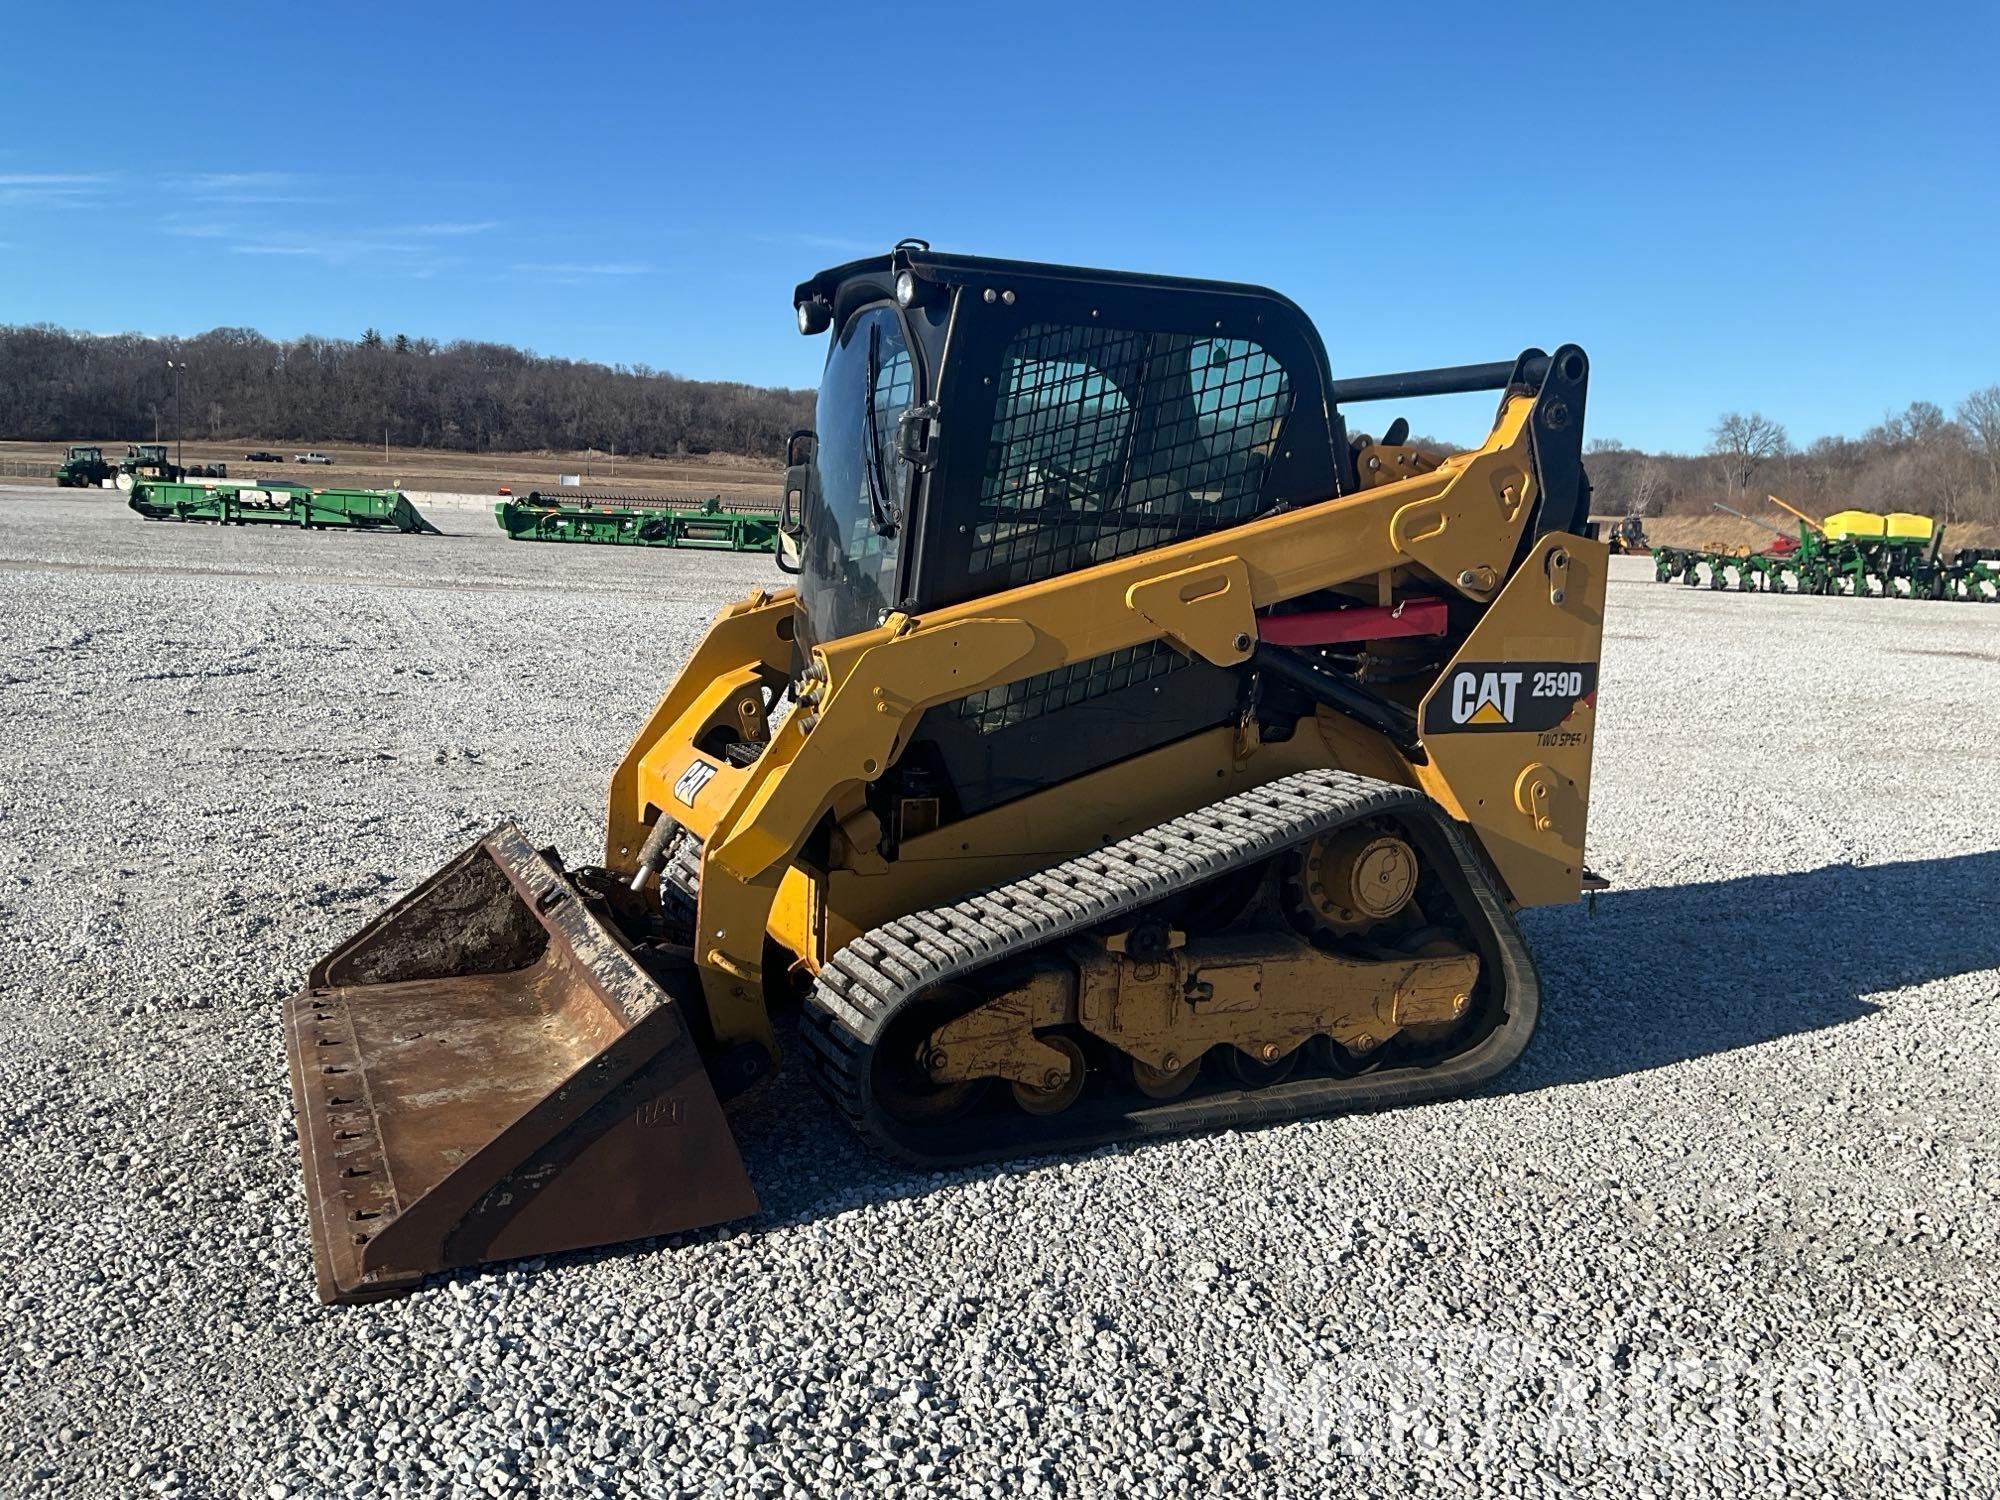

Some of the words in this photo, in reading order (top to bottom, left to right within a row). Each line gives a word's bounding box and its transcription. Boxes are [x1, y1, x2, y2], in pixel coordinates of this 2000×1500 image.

[1452, 672, 1523, 724] CAT
[1532, 671, 1582, 697] 259D
[1536, 732, 1558, 747] TWO
[674, 760, 718, 807] CAT
